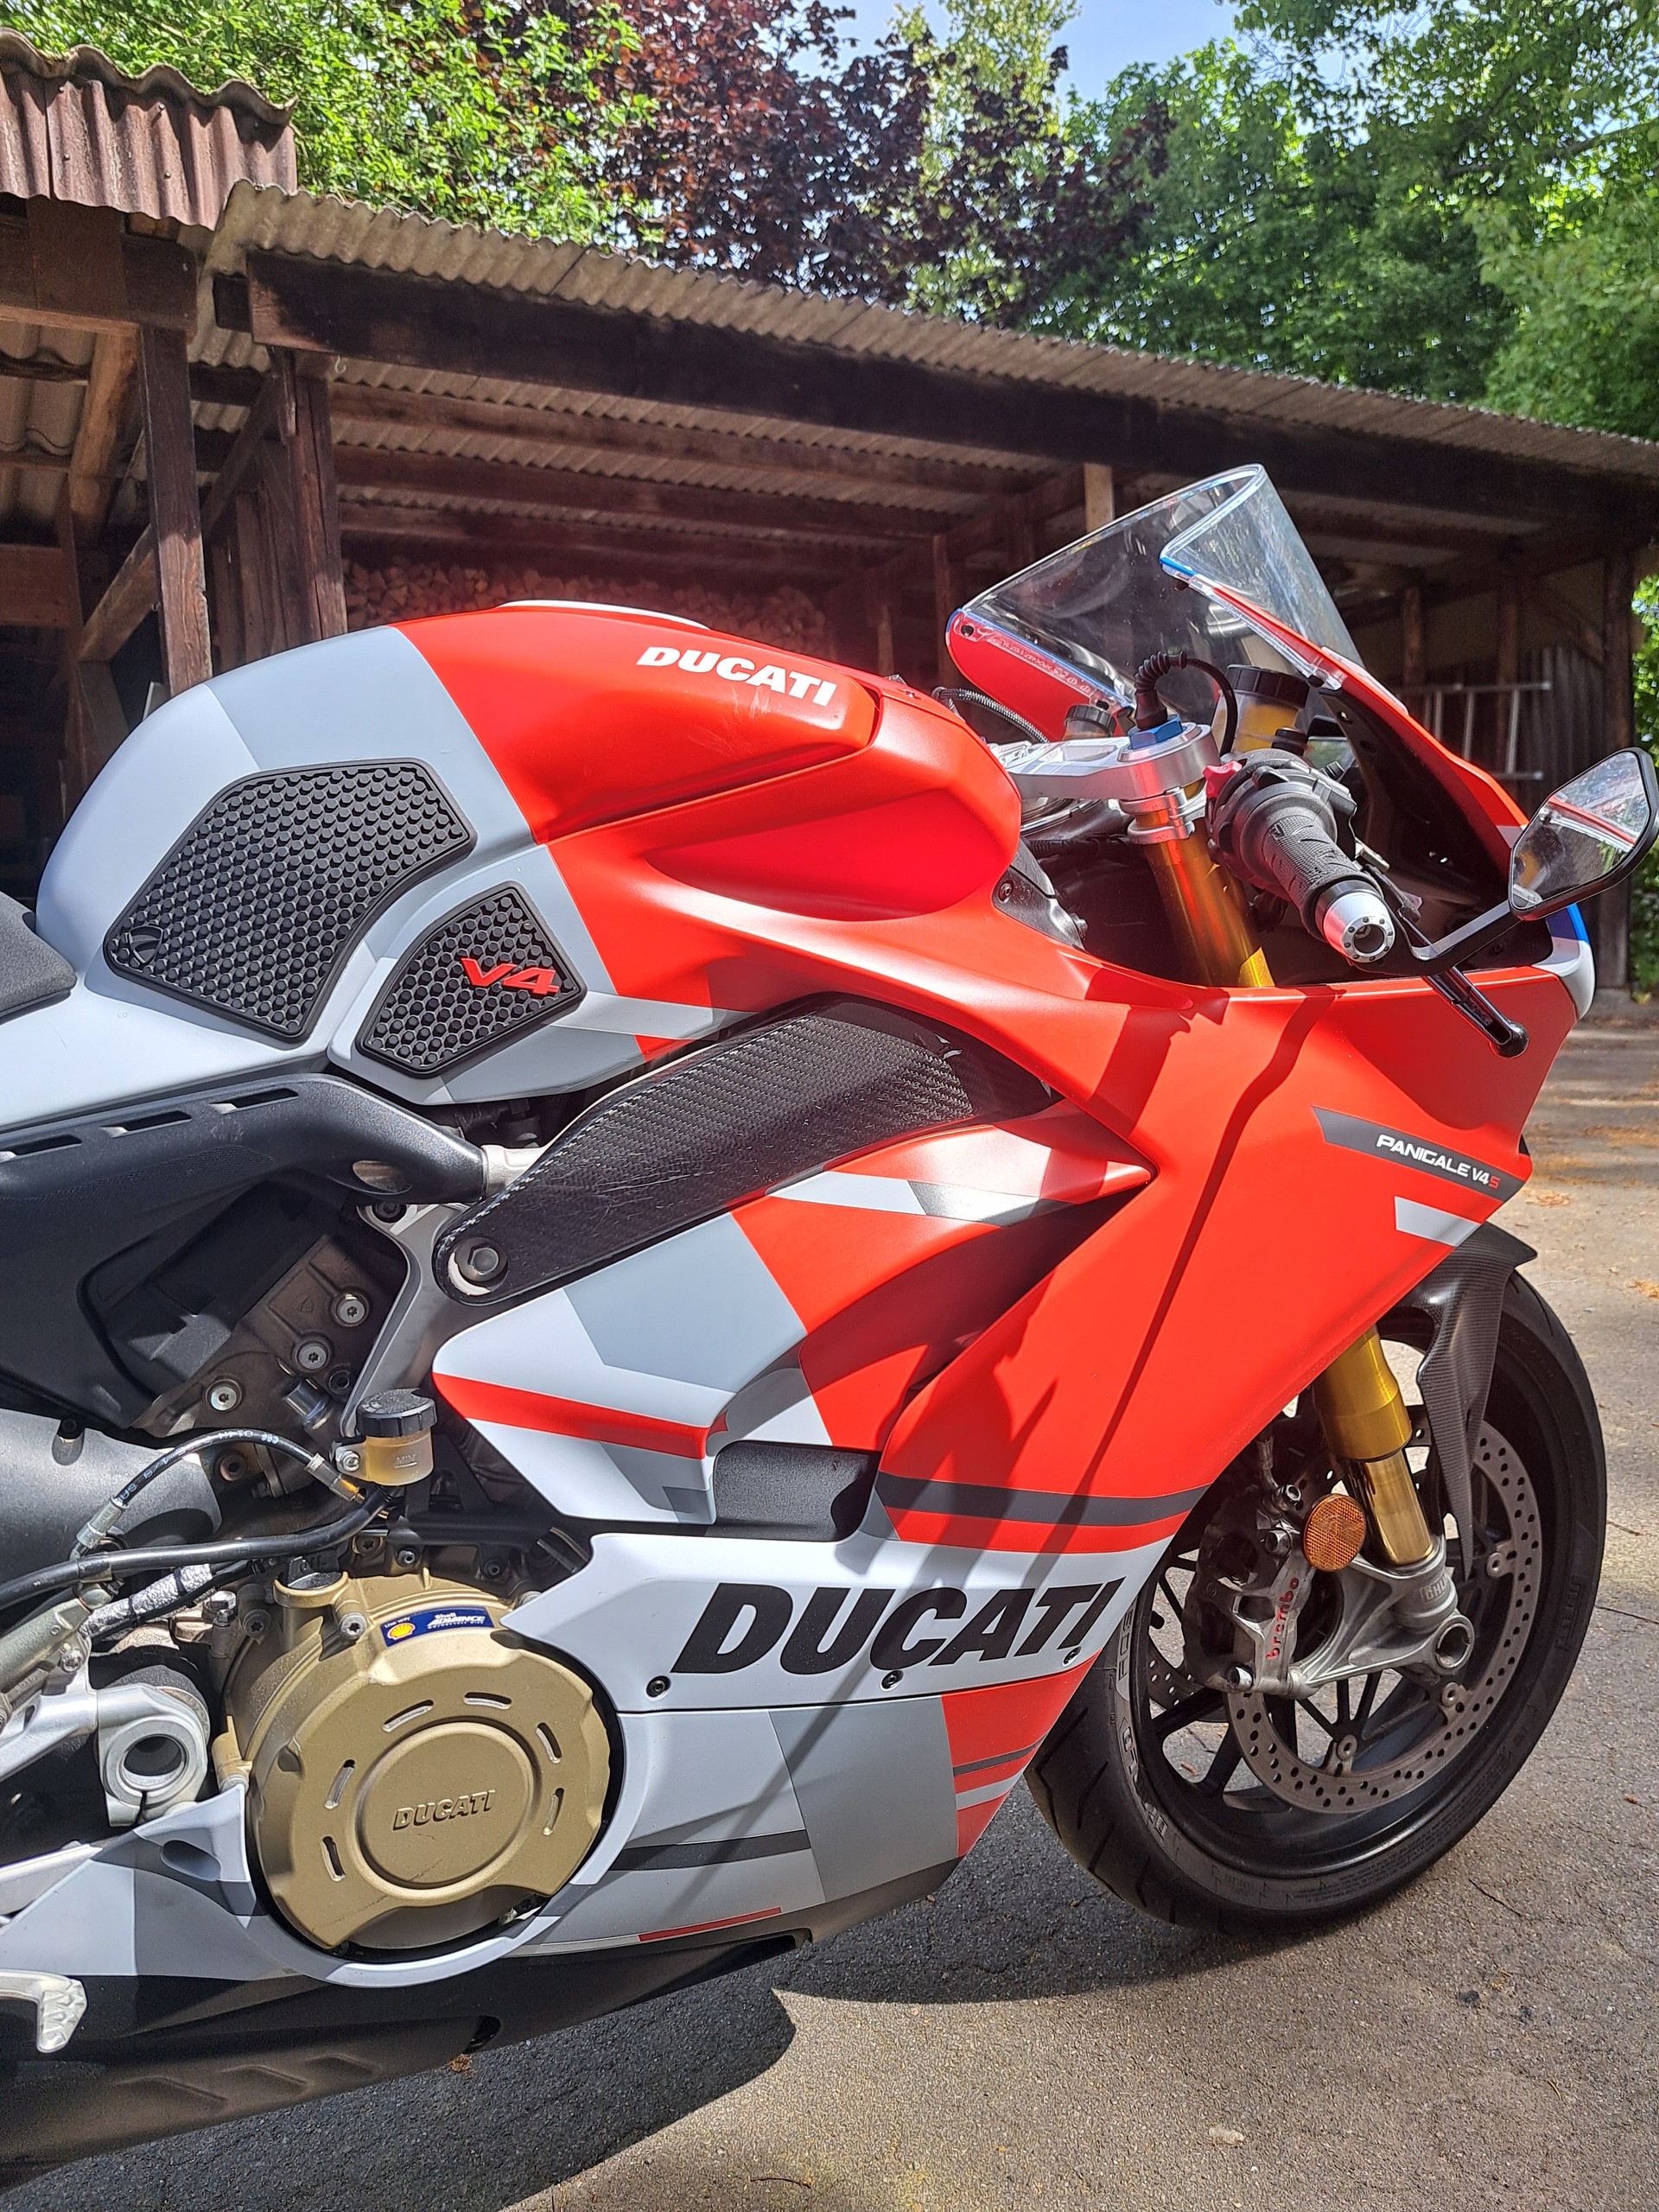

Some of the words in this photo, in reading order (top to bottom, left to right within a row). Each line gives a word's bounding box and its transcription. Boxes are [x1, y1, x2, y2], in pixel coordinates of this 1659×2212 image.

[636, 646, 837, 707] DUCATI
[461, 957, 560, 995] V4
[1376, 1134, 1471, 1178] PANIGALE
[1471, 1167, 1501, 1189] V4S
[427, 1616, 486, 1626] ADVANCE
[670, 1576, 1126, 1675] DUCATI
[1265, 1577, 1299, 1659] brembo
[392, 1789, 496, 1831] DUCATI
